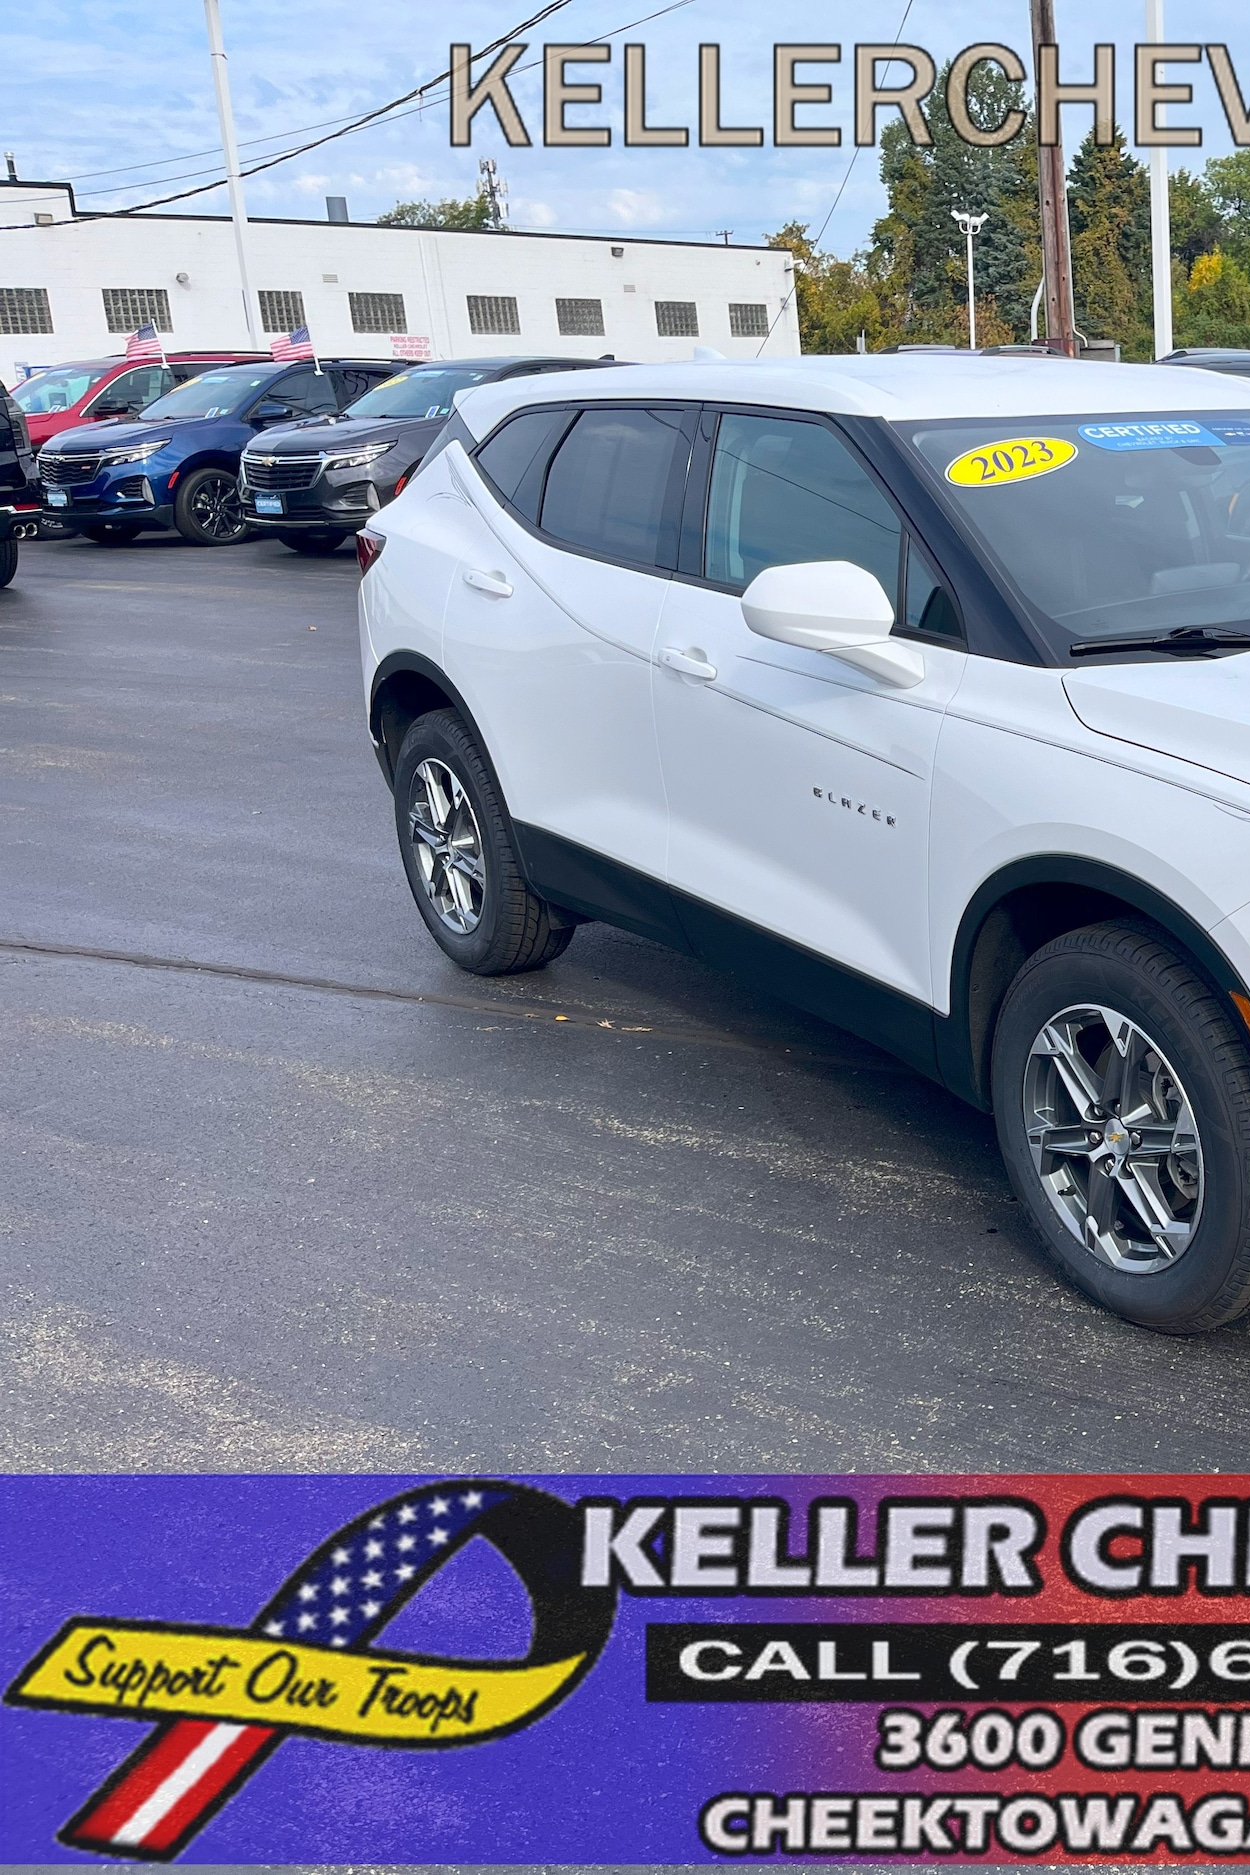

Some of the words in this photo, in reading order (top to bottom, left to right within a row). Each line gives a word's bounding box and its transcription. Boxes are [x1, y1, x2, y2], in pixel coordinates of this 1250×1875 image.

[1083, 423, 1201, 439] CERTIFIED
[970, 441, 1054, 481] 2023
[812, 786, 897, 828] BLAZER
